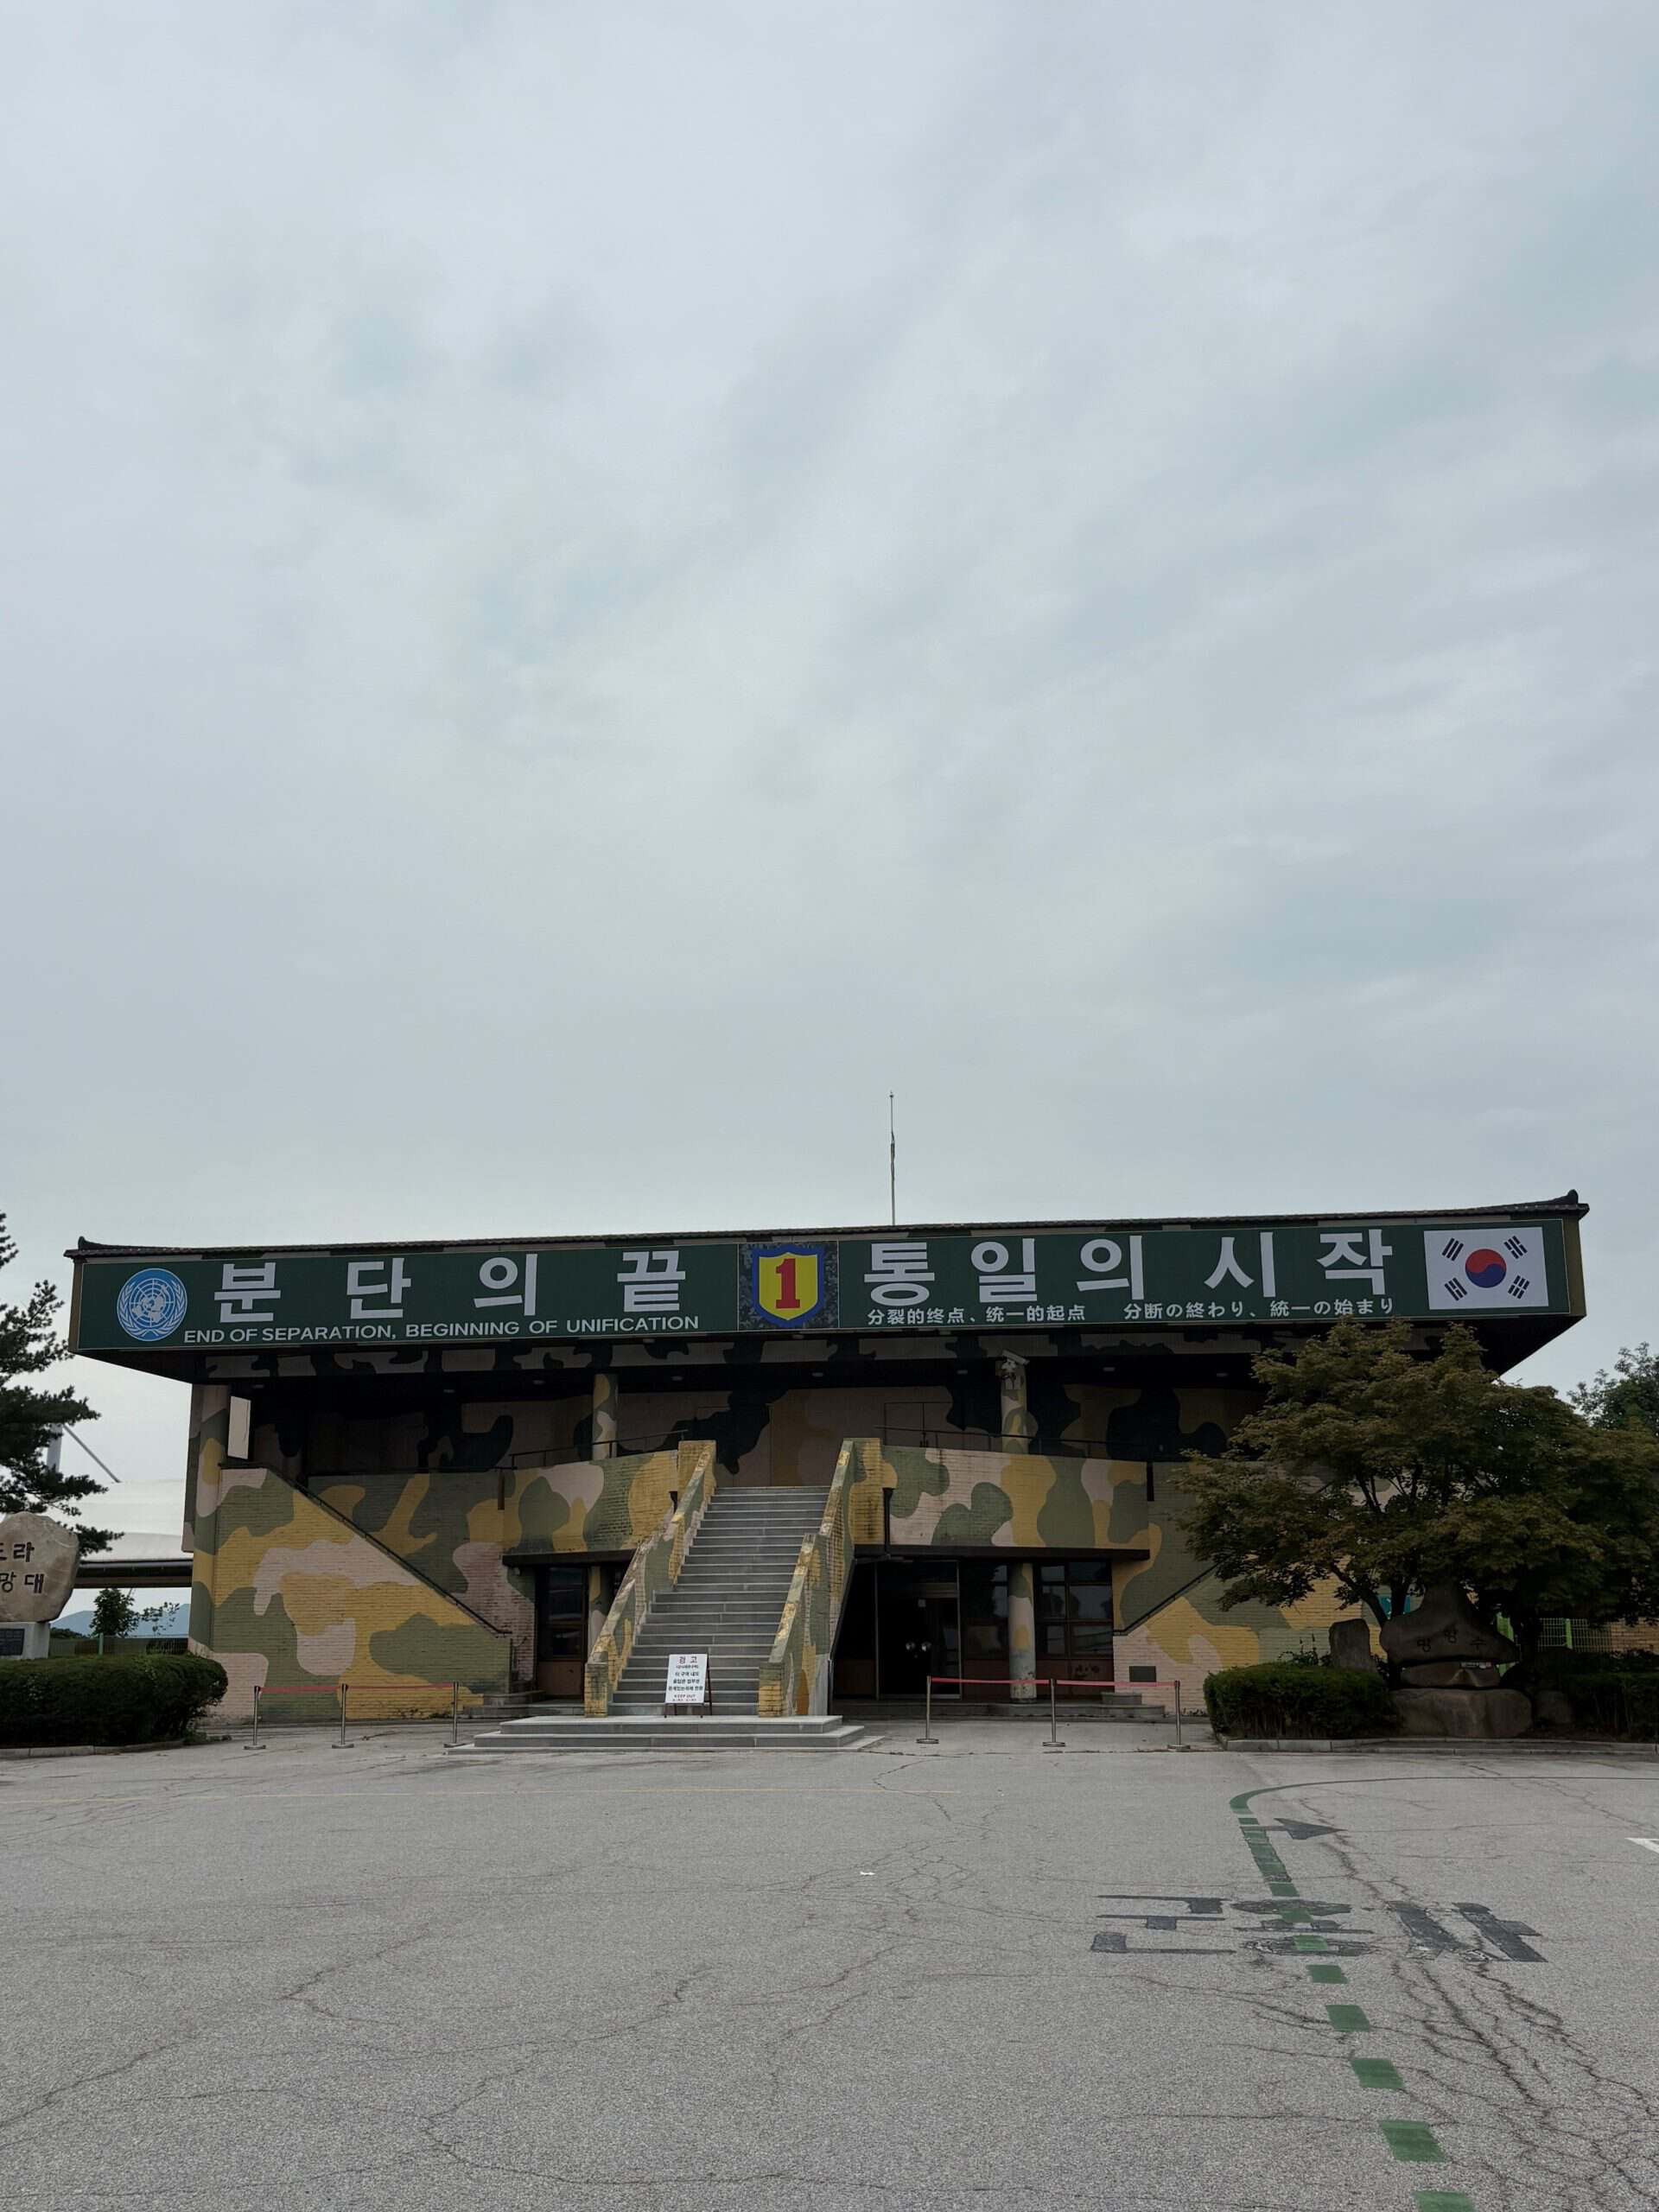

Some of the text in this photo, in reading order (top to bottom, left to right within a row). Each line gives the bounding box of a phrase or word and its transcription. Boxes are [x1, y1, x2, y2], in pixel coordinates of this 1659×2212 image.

[617, 1250, 686, 1313] 끝
[775, 1258, 801, 1309] 1
[184, 1316, 700, 1343] END OF SEPARATION, BEGINNING OF UNIFICATION
